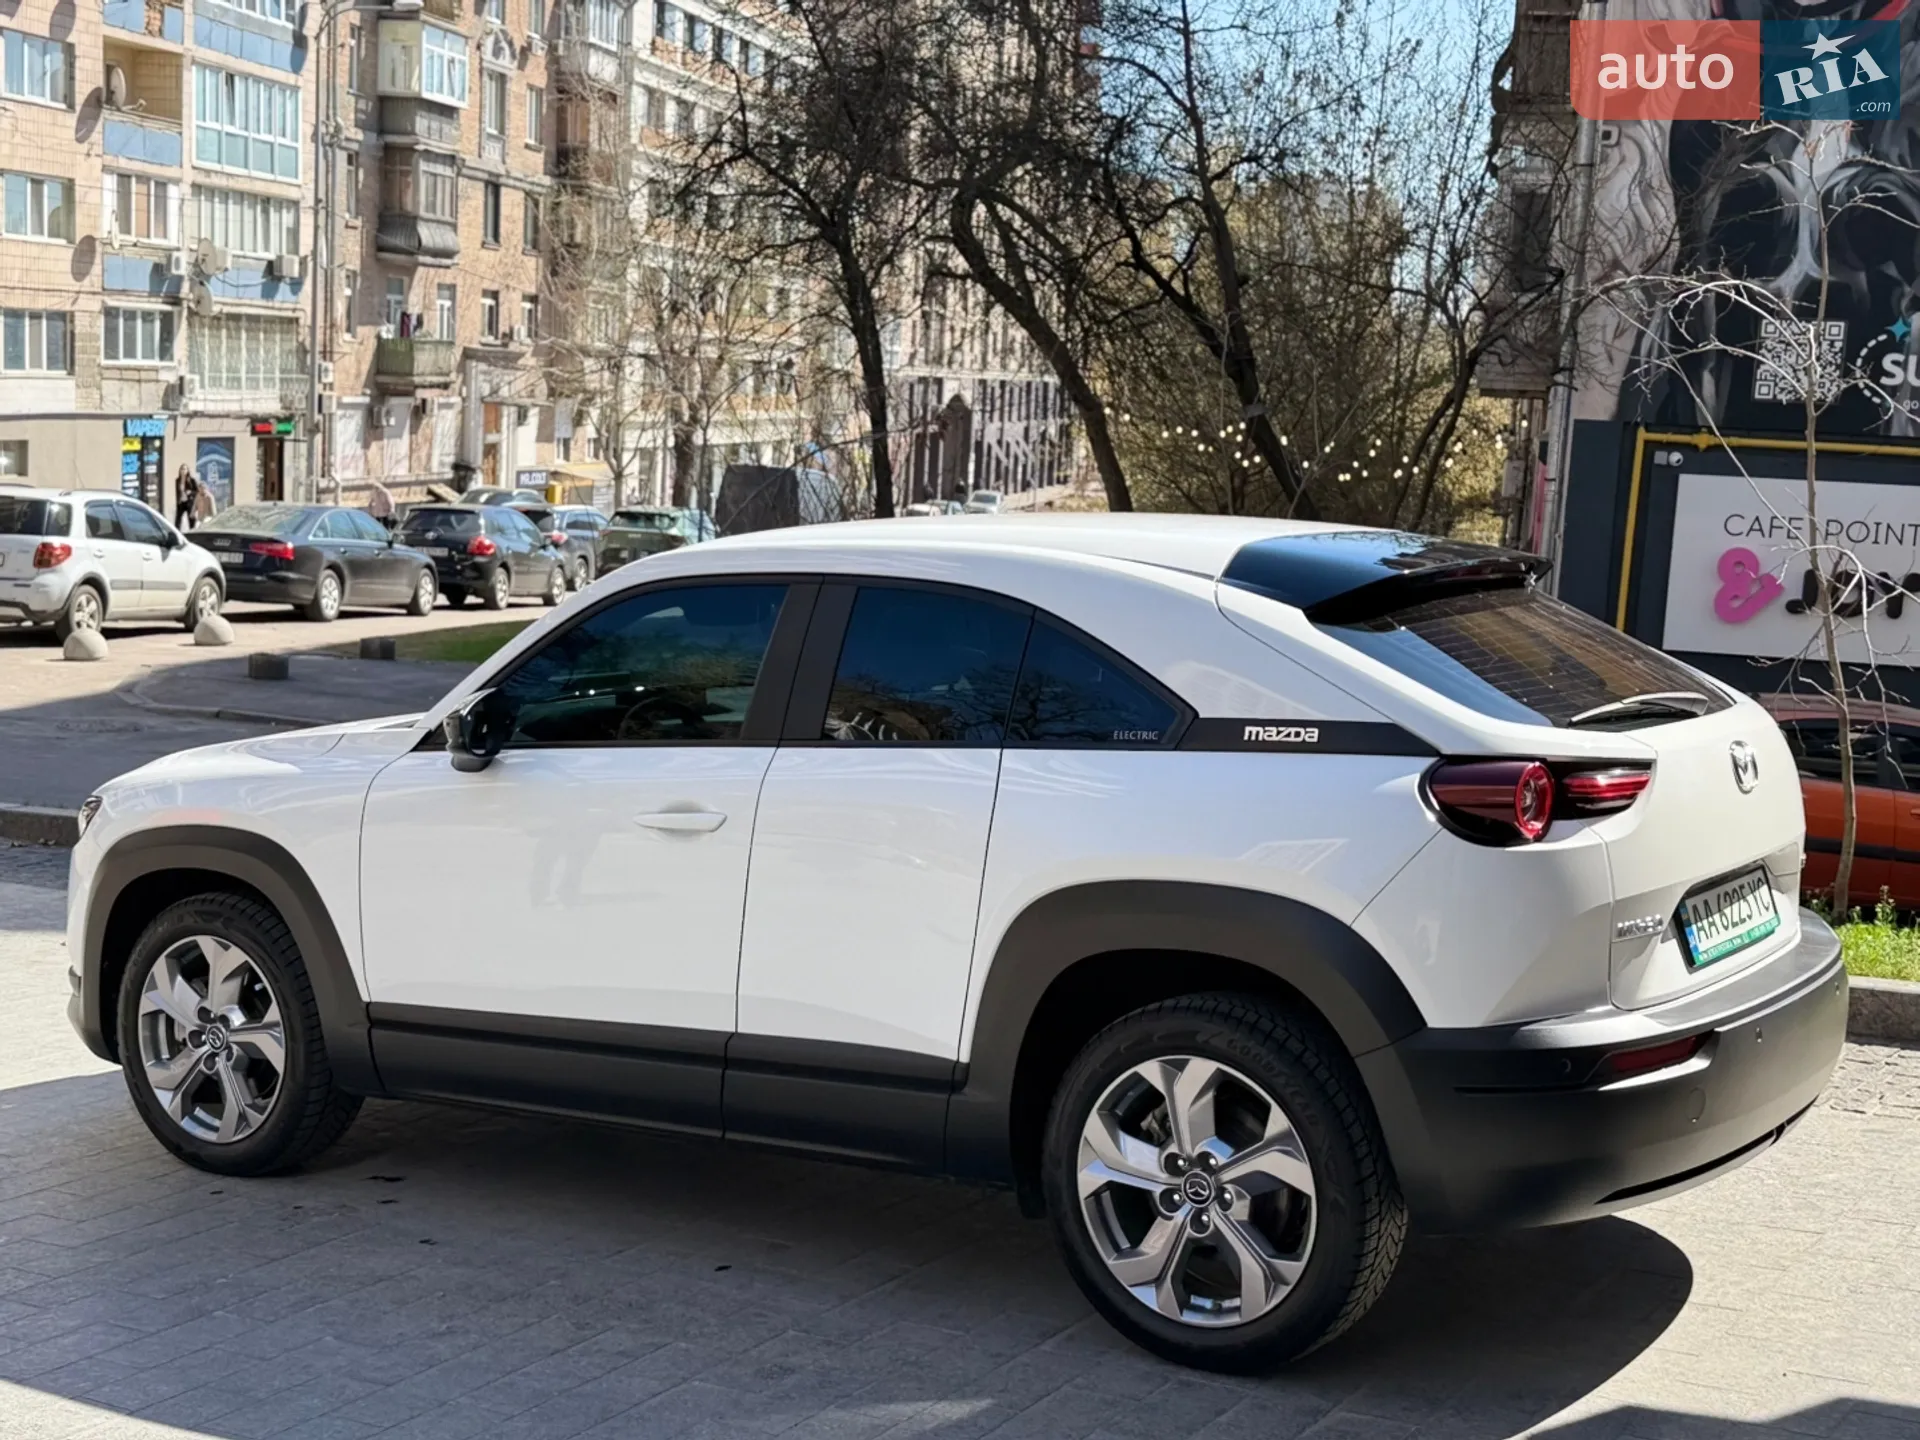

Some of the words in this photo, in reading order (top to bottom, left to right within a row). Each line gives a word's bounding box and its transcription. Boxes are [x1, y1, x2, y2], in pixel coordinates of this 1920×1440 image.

[1724, 513, 1804, 540] CAFE
[1825, 518, 1920, 547] POINT
[1113, 730, 1159, 741] ELECTRIC
[1692, 896, 1720, 943] AA
[1717, 884, 1754, 931] 6225
[1749, 877, 1771, 917] YC
